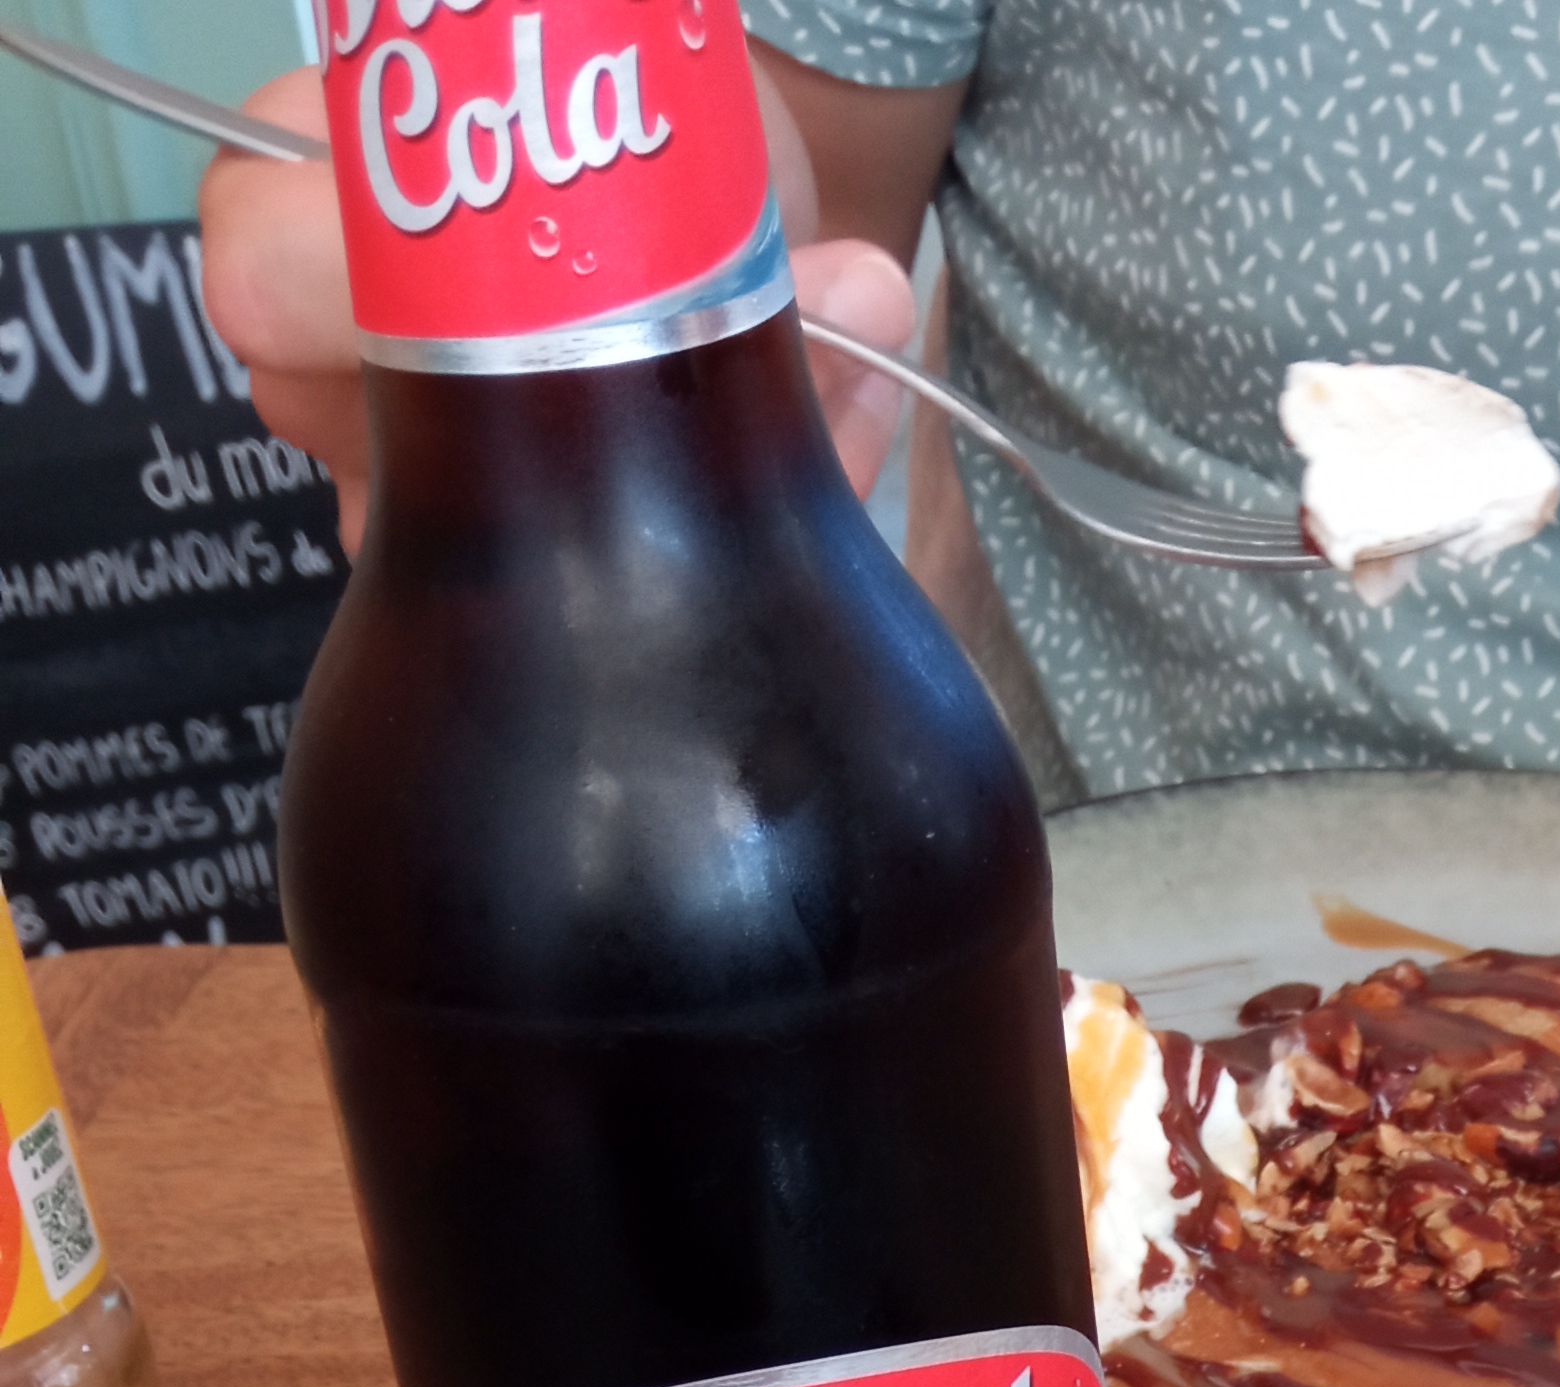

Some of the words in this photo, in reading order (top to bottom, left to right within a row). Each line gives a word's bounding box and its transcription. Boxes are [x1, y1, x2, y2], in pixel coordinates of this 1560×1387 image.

[359, 13, 671, 232] Cola
[140, 423, 213, 510] du
[0, 520, 282, 623] HAMPIGNONS
[12, 721, 181, 797] POMMES
